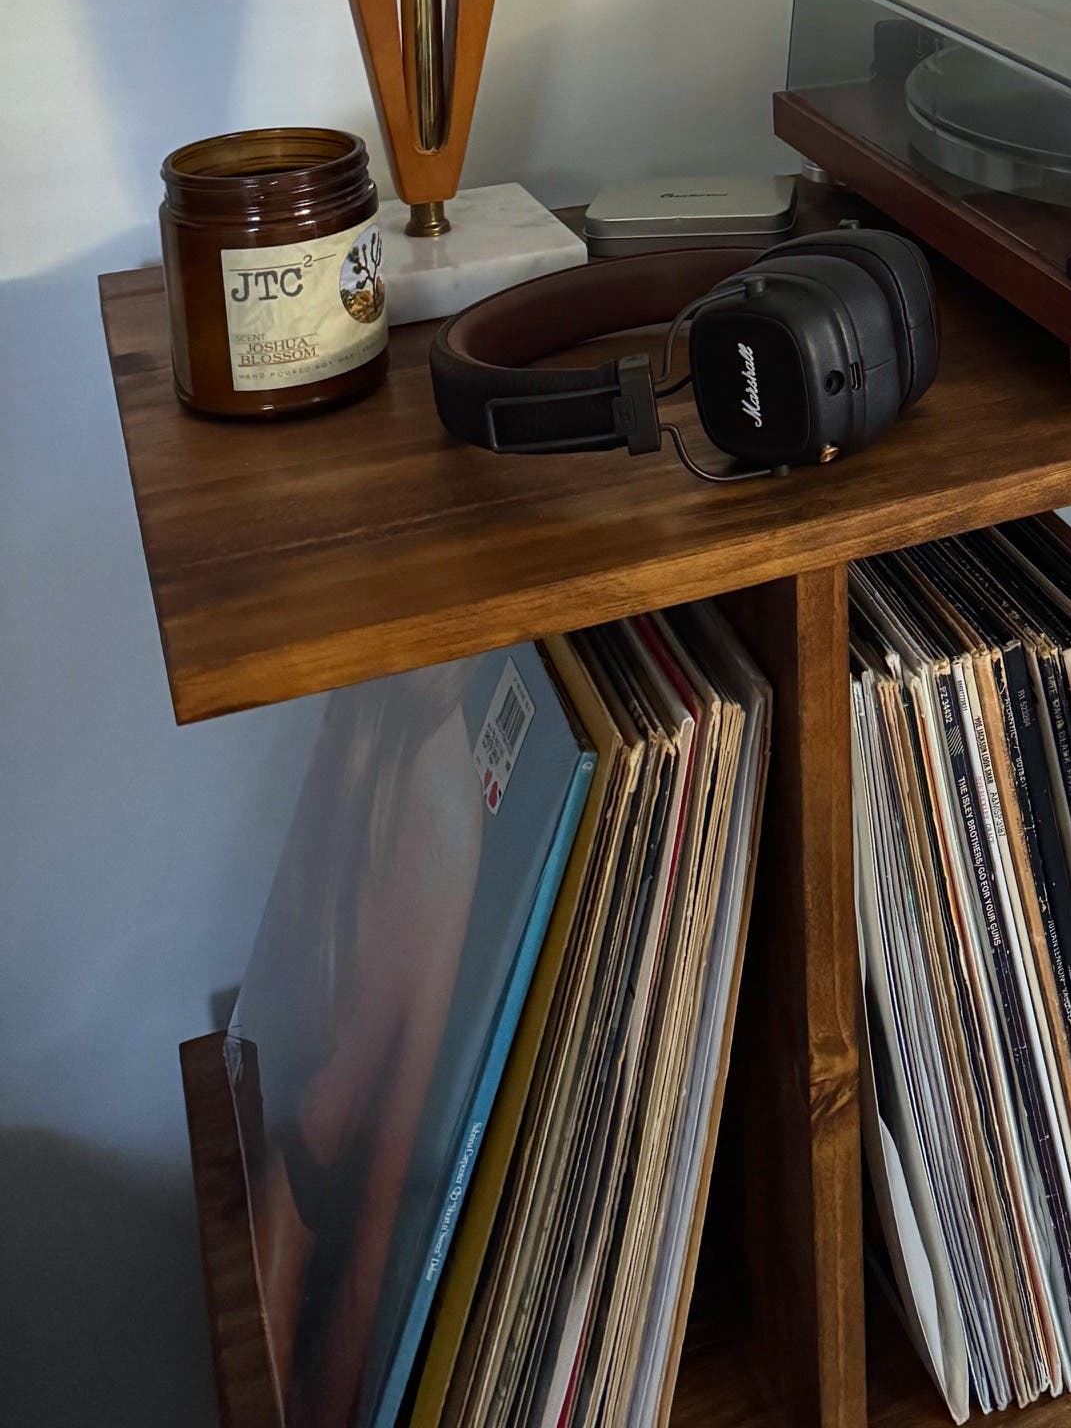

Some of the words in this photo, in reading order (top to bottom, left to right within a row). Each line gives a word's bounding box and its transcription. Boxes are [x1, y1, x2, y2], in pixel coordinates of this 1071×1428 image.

[241, 346, 316, 365] BLOSSOM
[246, 338, 309, 354] JOSHUA
[738, 343, 762, 427] Marshall
[939, 686, 947, 699] PZ
[941, 699, 952, 723] 34432
[974, 716, 982, 728] JOE
[976, 728, 988, 753] JACKSON
[981, 753, 991, 768] LOOK
[957, 776, 967, 794] THE
[961, 794, 973, 818] ISLEY
[980, 880, 990, 898] FOR
[984, 898, 995, 921] YOUR
[989, 921, 1001, 946] GUNS
[1045, 918, 1060, 947] JULIAN
